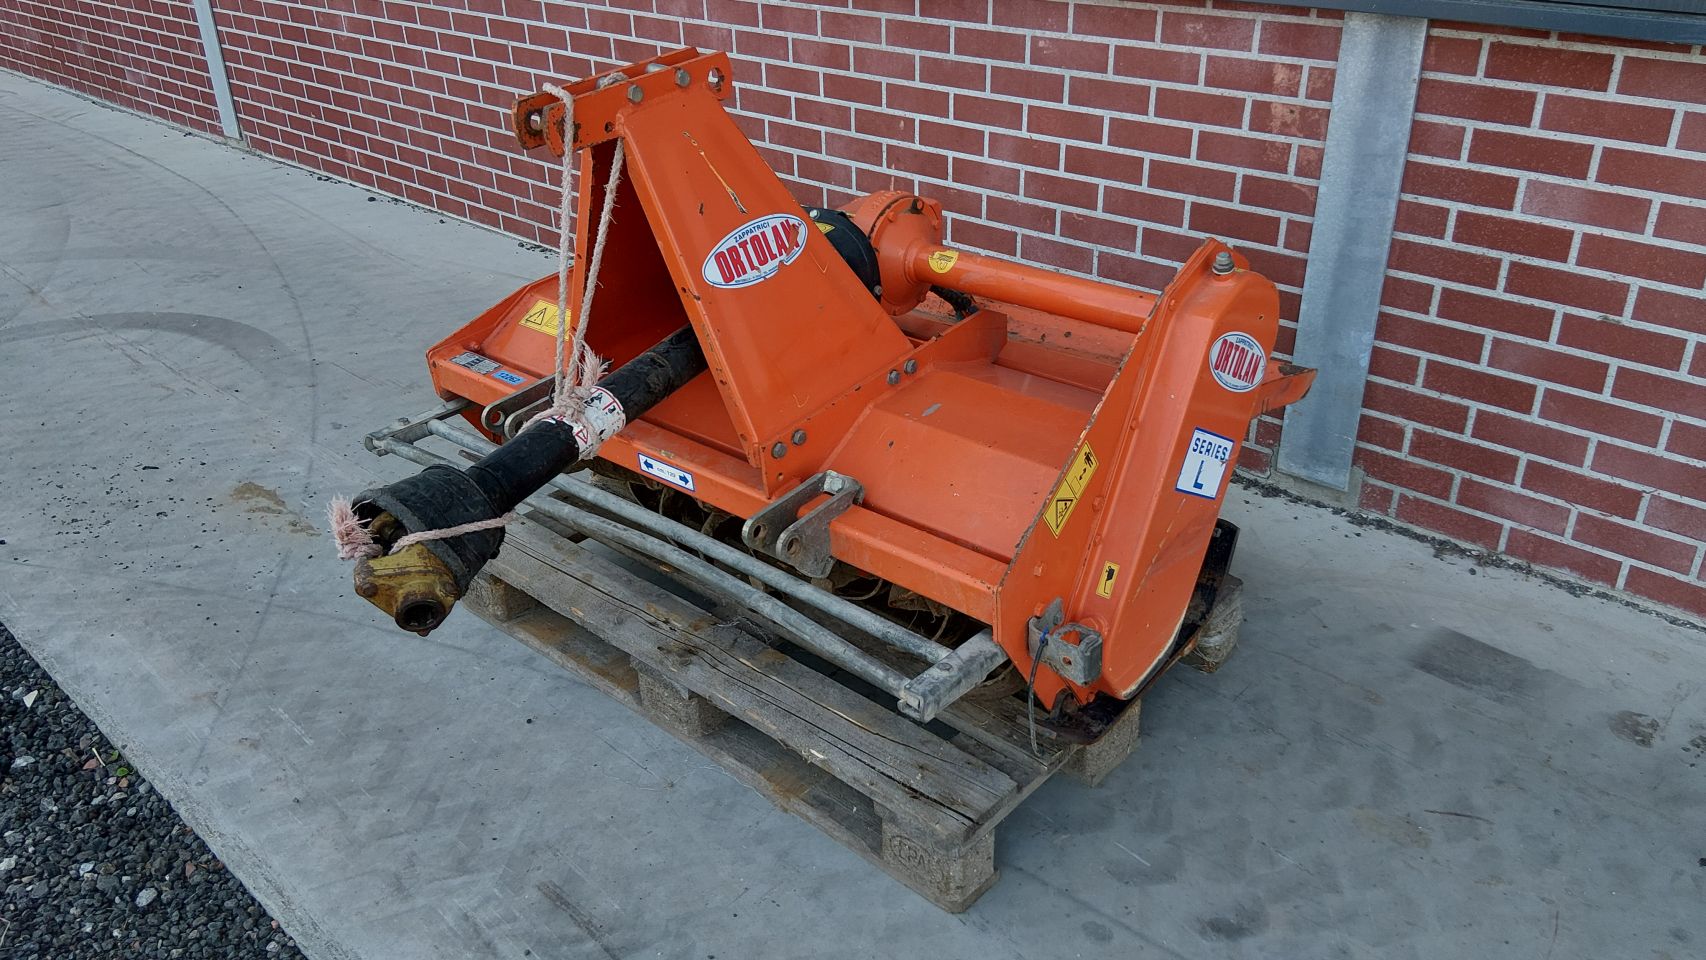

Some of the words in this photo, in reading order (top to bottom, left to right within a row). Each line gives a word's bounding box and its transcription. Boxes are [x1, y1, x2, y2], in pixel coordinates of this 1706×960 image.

[734, 222, 770, 243] ZAPPATRICI
[1214, 338, 1262, 385] ORTOLAN
[1193, 437, 1228, 460] SERIES
[1193, 460, 1204, 490] L
